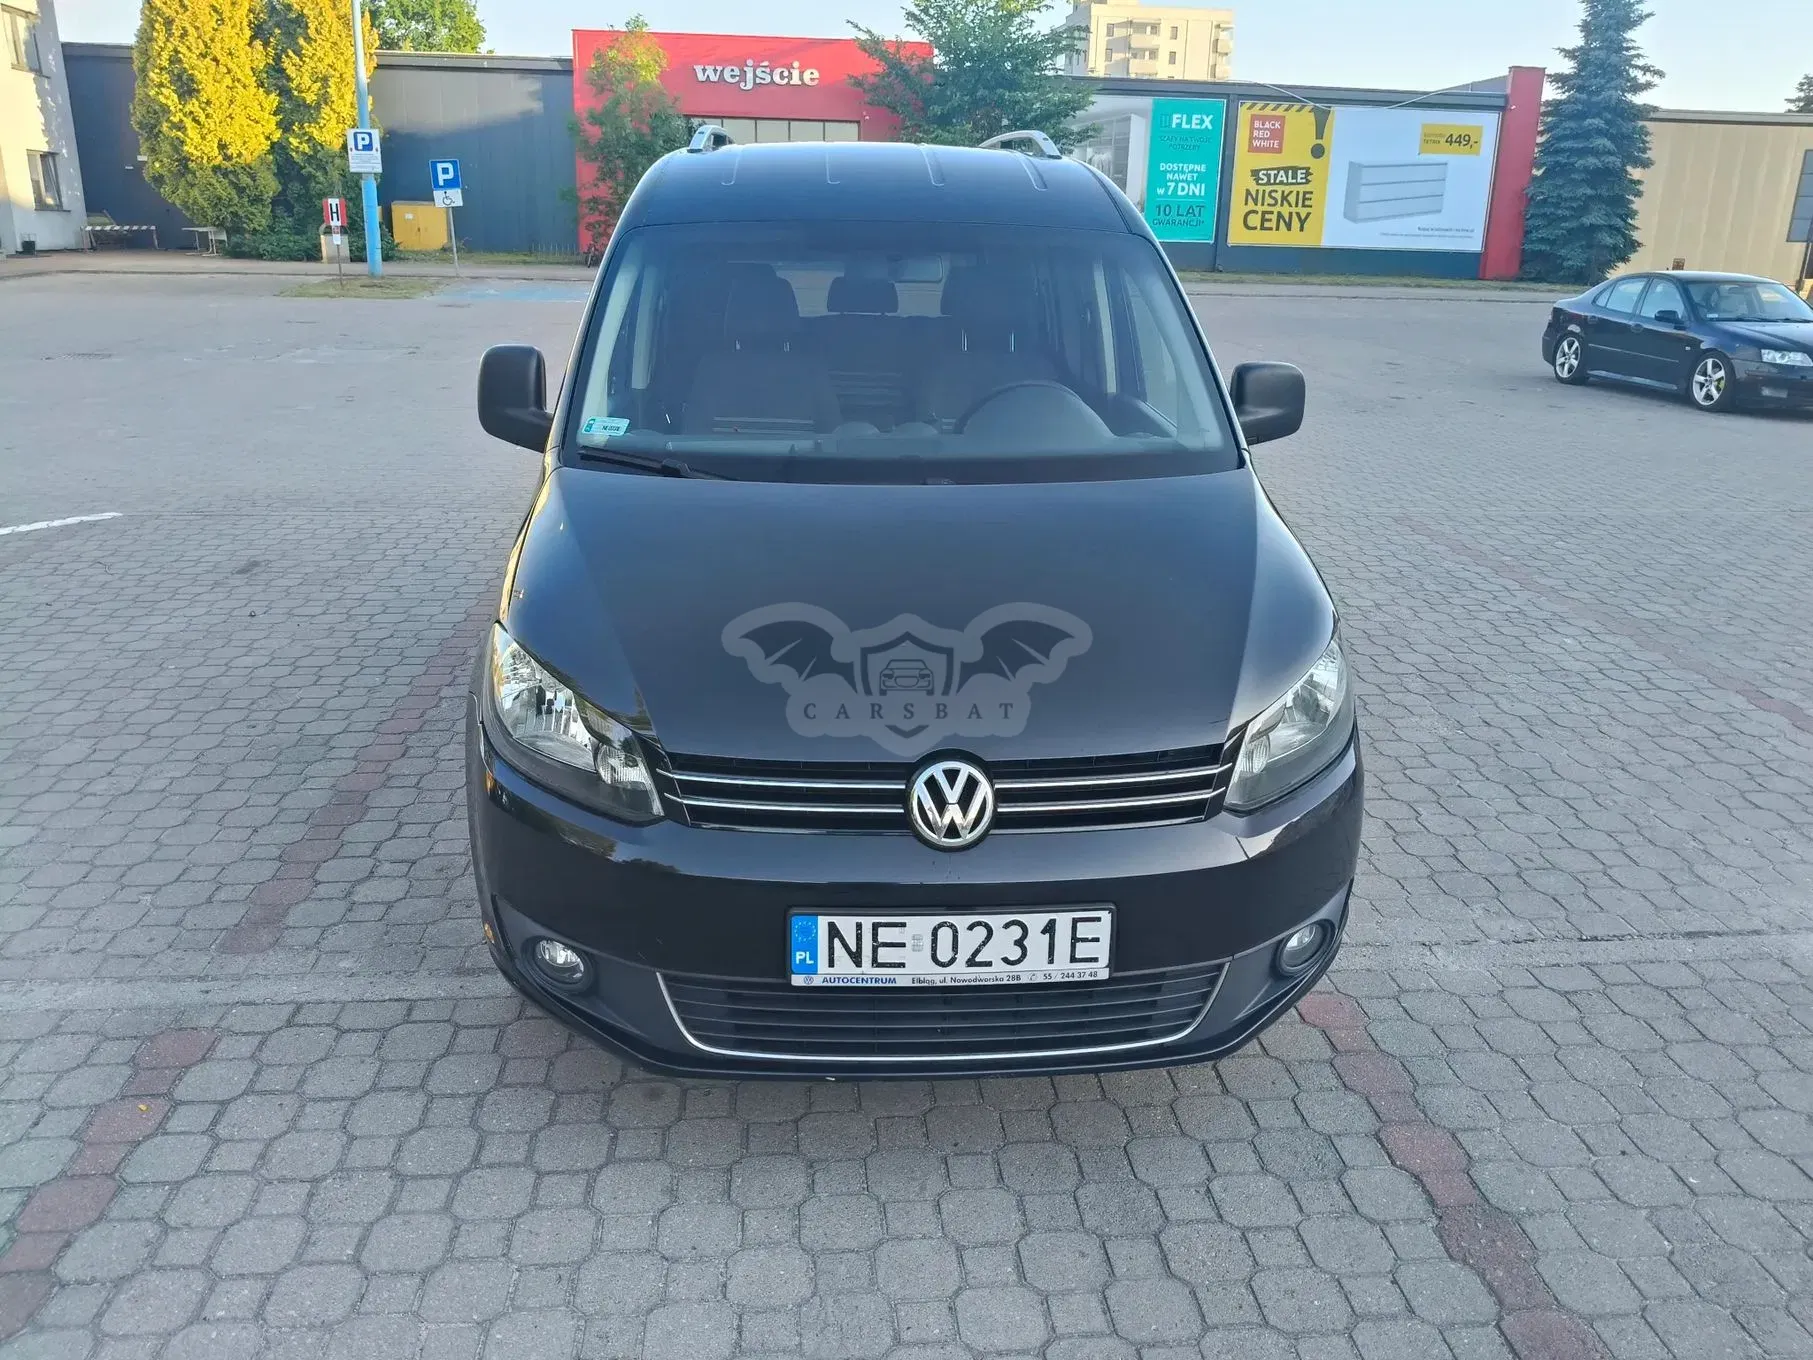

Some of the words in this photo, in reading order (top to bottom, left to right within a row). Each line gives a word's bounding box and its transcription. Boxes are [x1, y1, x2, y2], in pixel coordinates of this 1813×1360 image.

[693, 58, 820, 91] wejście
[1254, 120, 1281, 129] BLACK
[356, 133, 370, 149] P
[1252, 129, 1271, 138] RED
[1252, 139, 1280, 149] WHITE
[436, 162, 455, 187] P
[1159, 162, 1207, 173] DOSTĘPNE
[1166, 172, 1199, 181] NAWET
[1258, 169, 1307, 184] STALE
[1166, 181, 1175, 196] 7
[1176, 182, 1206, 197] DNI
[1244, 188, 1314, 208] NISKIE
[329, 203, 340, 222] H
[1155, 203, 1172, 217] 10
[1176, 204, 1205, 218] LAT
[1242, 209, 1312, 232] CENY
[827, 920, 908, 969] NE
[930, 916, 1103, 969] 0231E
[795, 952, 815, 965] PL
[821, 976, 897, 985] AUTOCENTRUM
[939, 976, 948, 984] ul.
[950, 974, 1005, 984] Nowodworska
[1006, 974, 1022, 982] 28B
[1043, 972, 1053, 980] 55
[1060, 971, 1075, 980] 244
[1077, 971, 1087, 979] 37
[1088, 970, 1098, 978] 48
